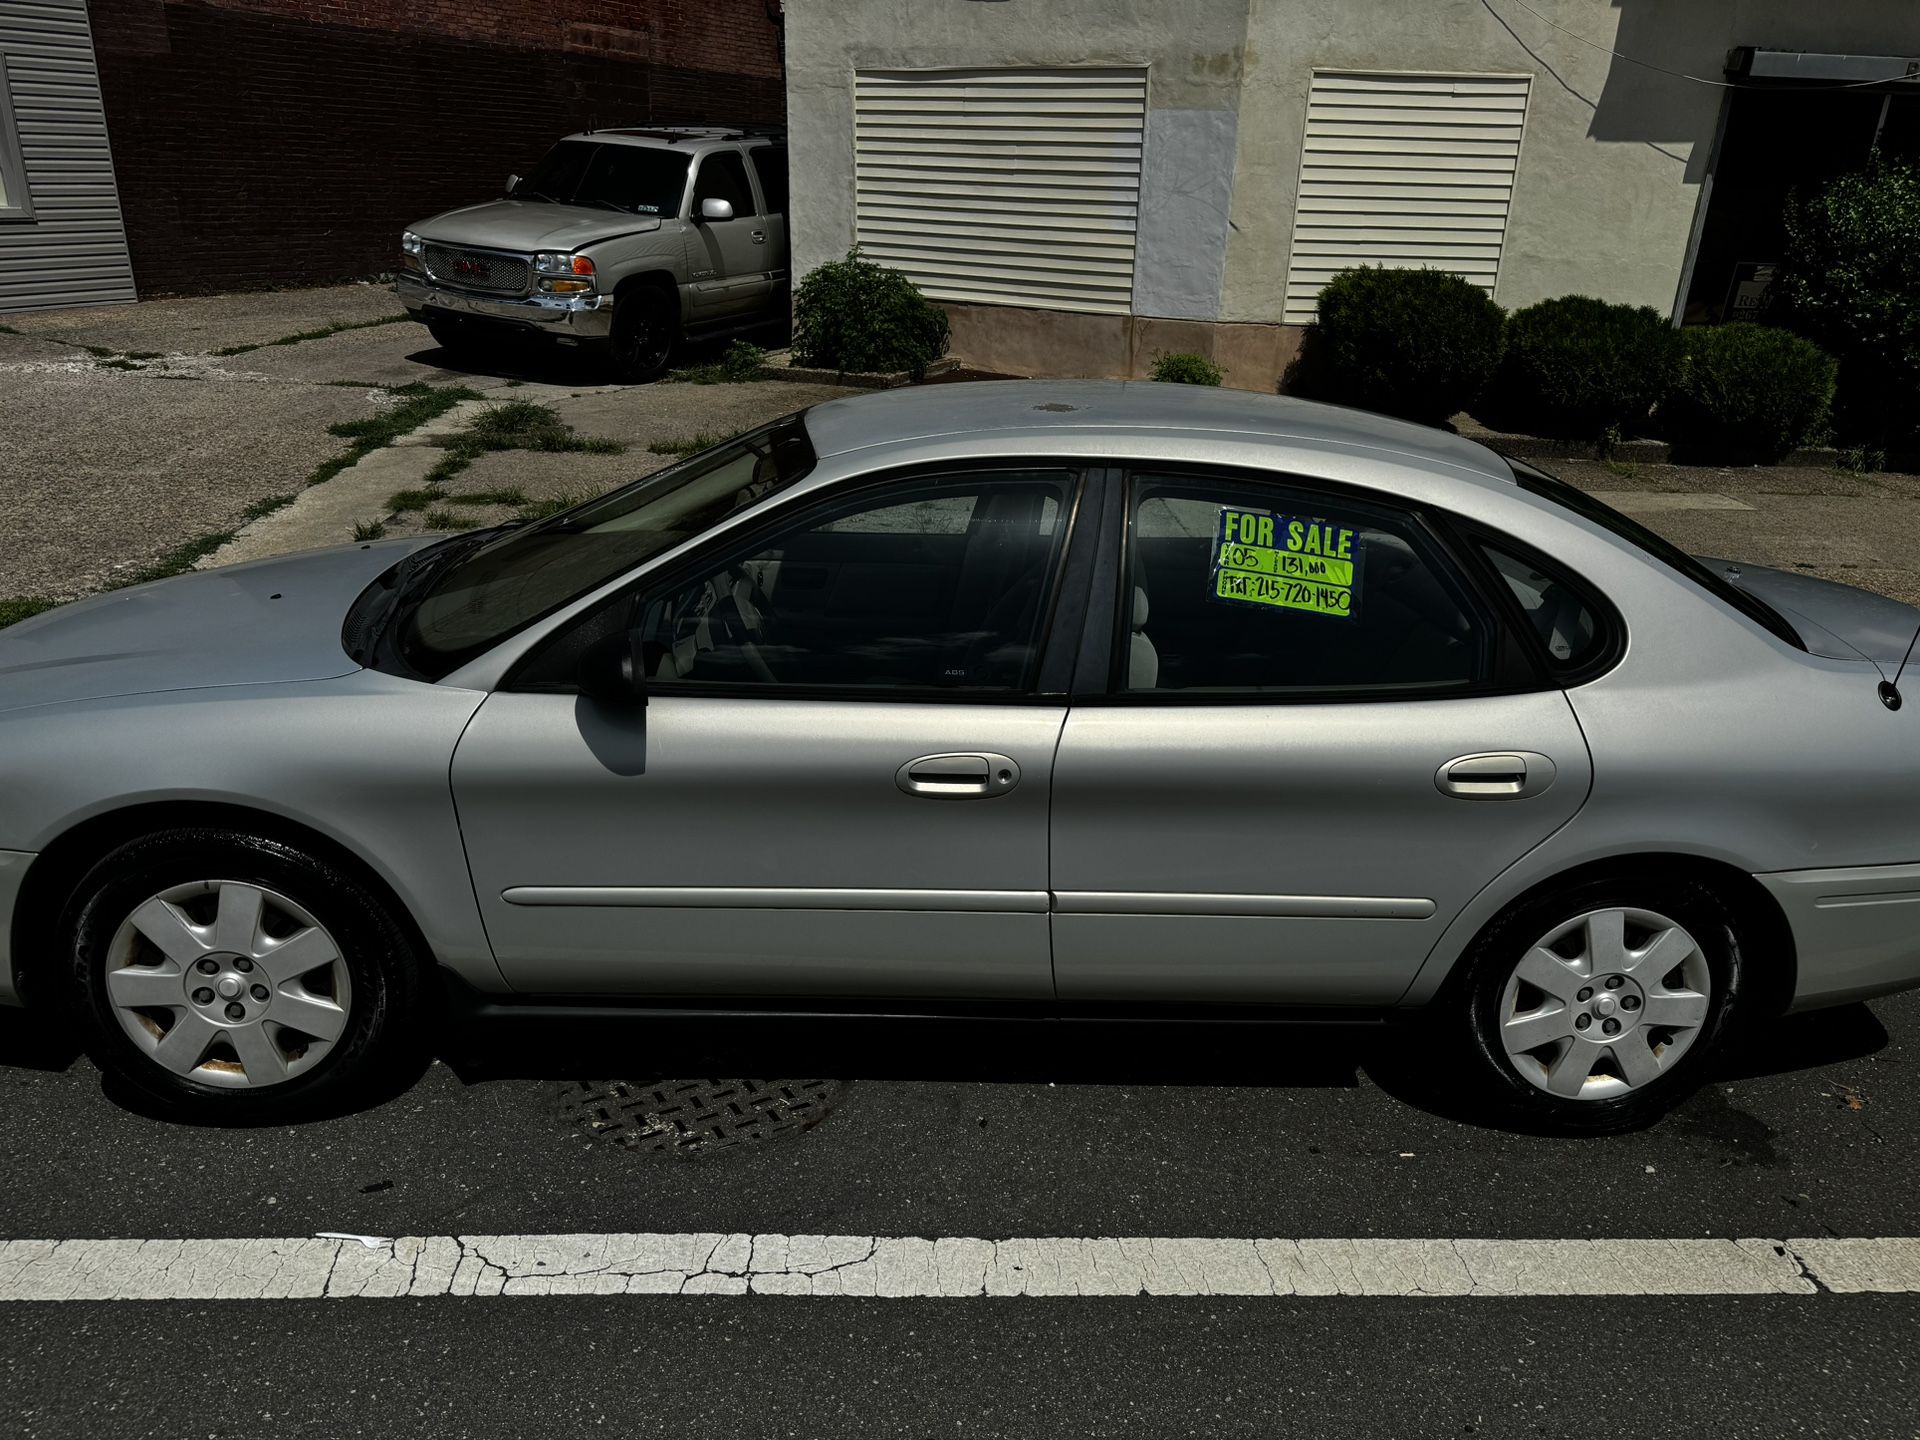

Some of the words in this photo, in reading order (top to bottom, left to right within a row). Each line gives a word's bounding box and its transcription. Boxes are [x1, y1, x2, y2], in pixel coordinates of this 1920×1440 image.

[1225, 512, 1275, 547] FOR
[1287, 521, 1354, 559] SALE
[1232, 547, 1259, 567] 05
[1282, 556, 1326, 577] 131,000
